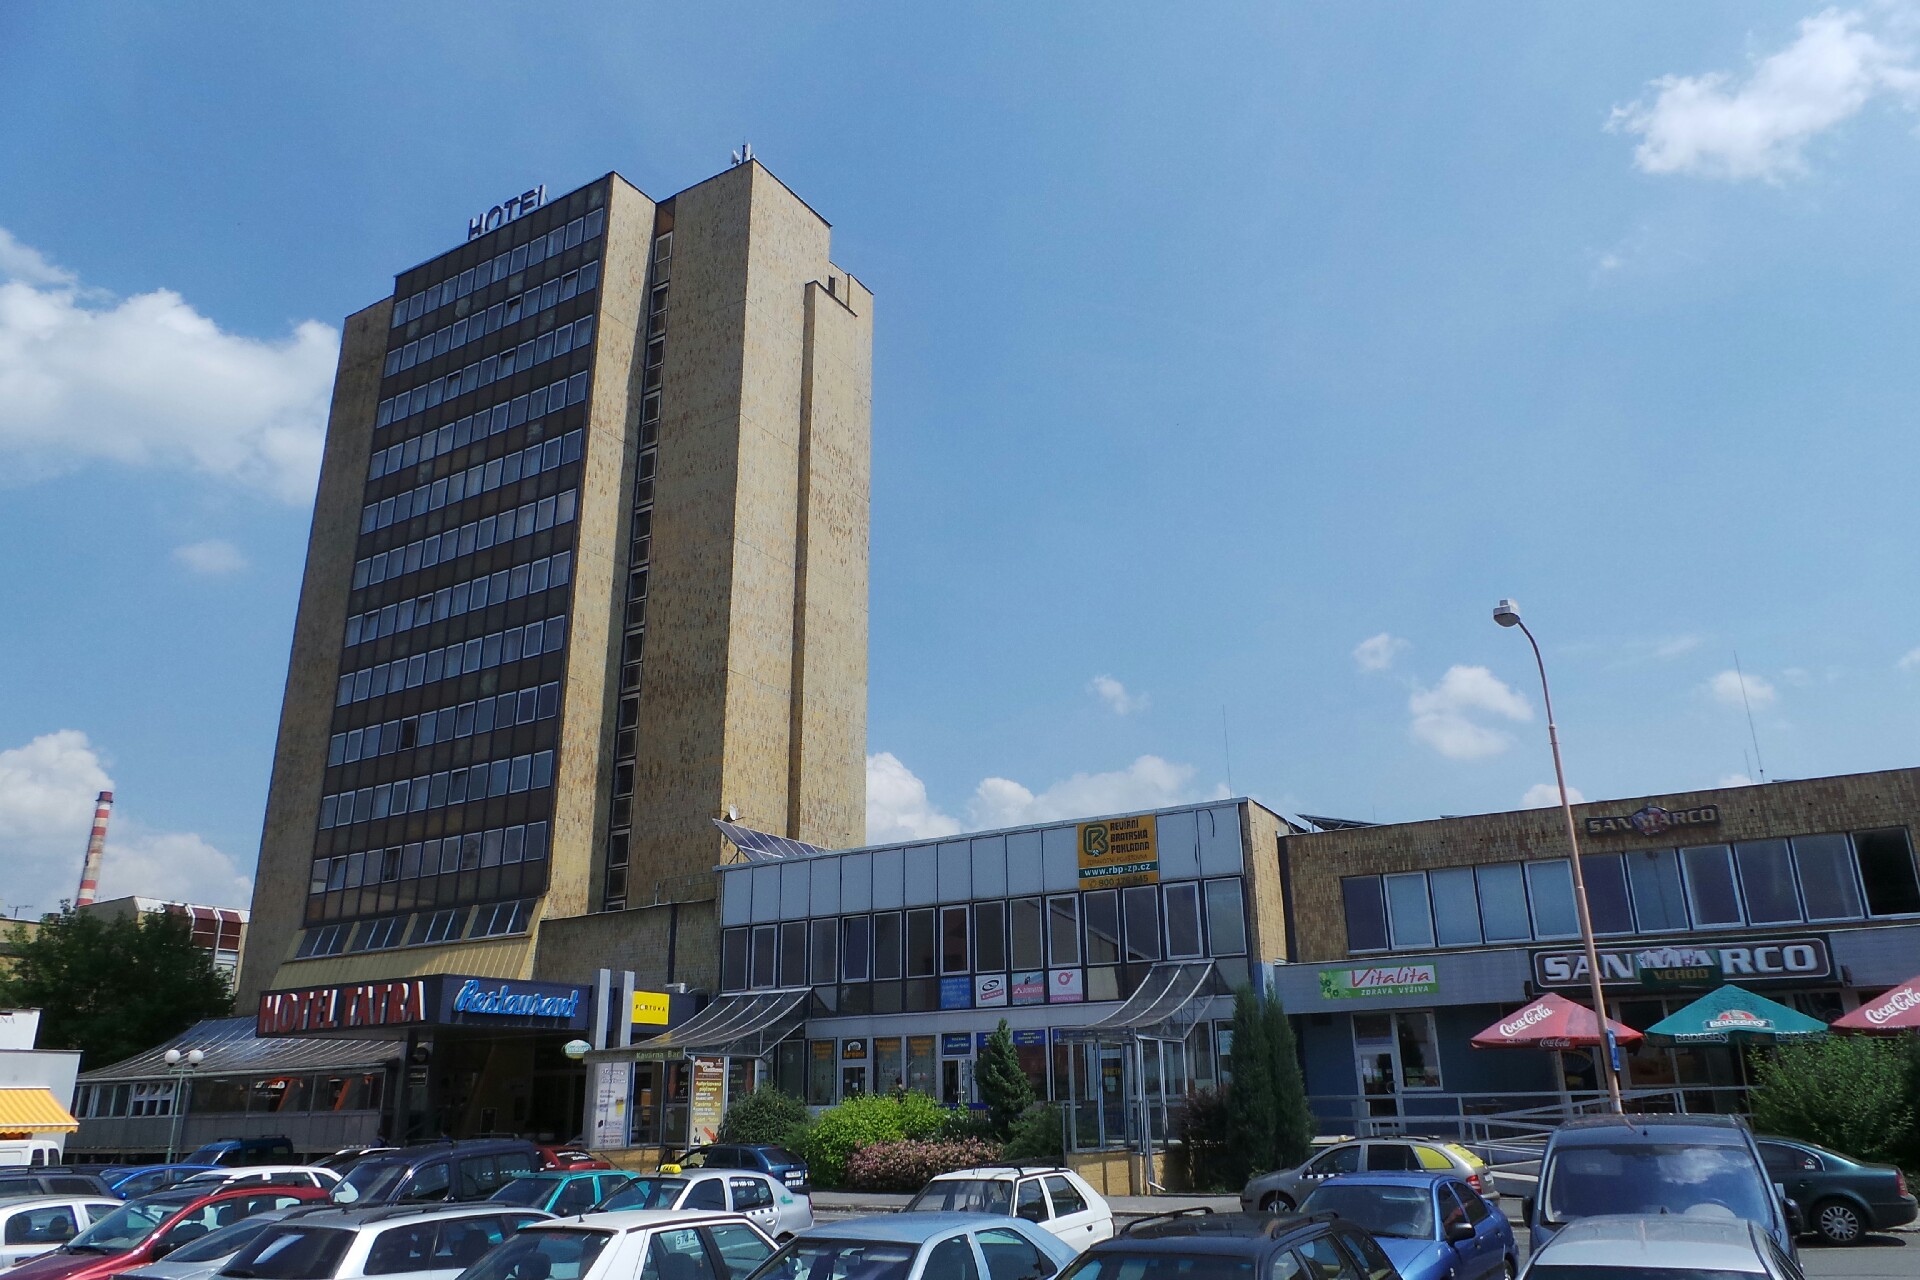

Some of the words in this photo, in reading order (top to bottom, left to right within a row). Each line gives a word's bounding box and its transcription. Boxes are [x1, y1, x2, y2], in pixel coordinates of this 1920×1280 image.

[1589, 818, 1632, 833] SAN
[1110, 842, 1150, 854] POKLADNA
[1084, 863, 1151, 876] www.rbp-zp.cz
[1352, 967, 1430, 988] Vitalita
[259, 989, 338, 1034] HOTEL
[343, 980, 426, 1028] TATRA
[453, 979, 578, 1018] Restaurant
